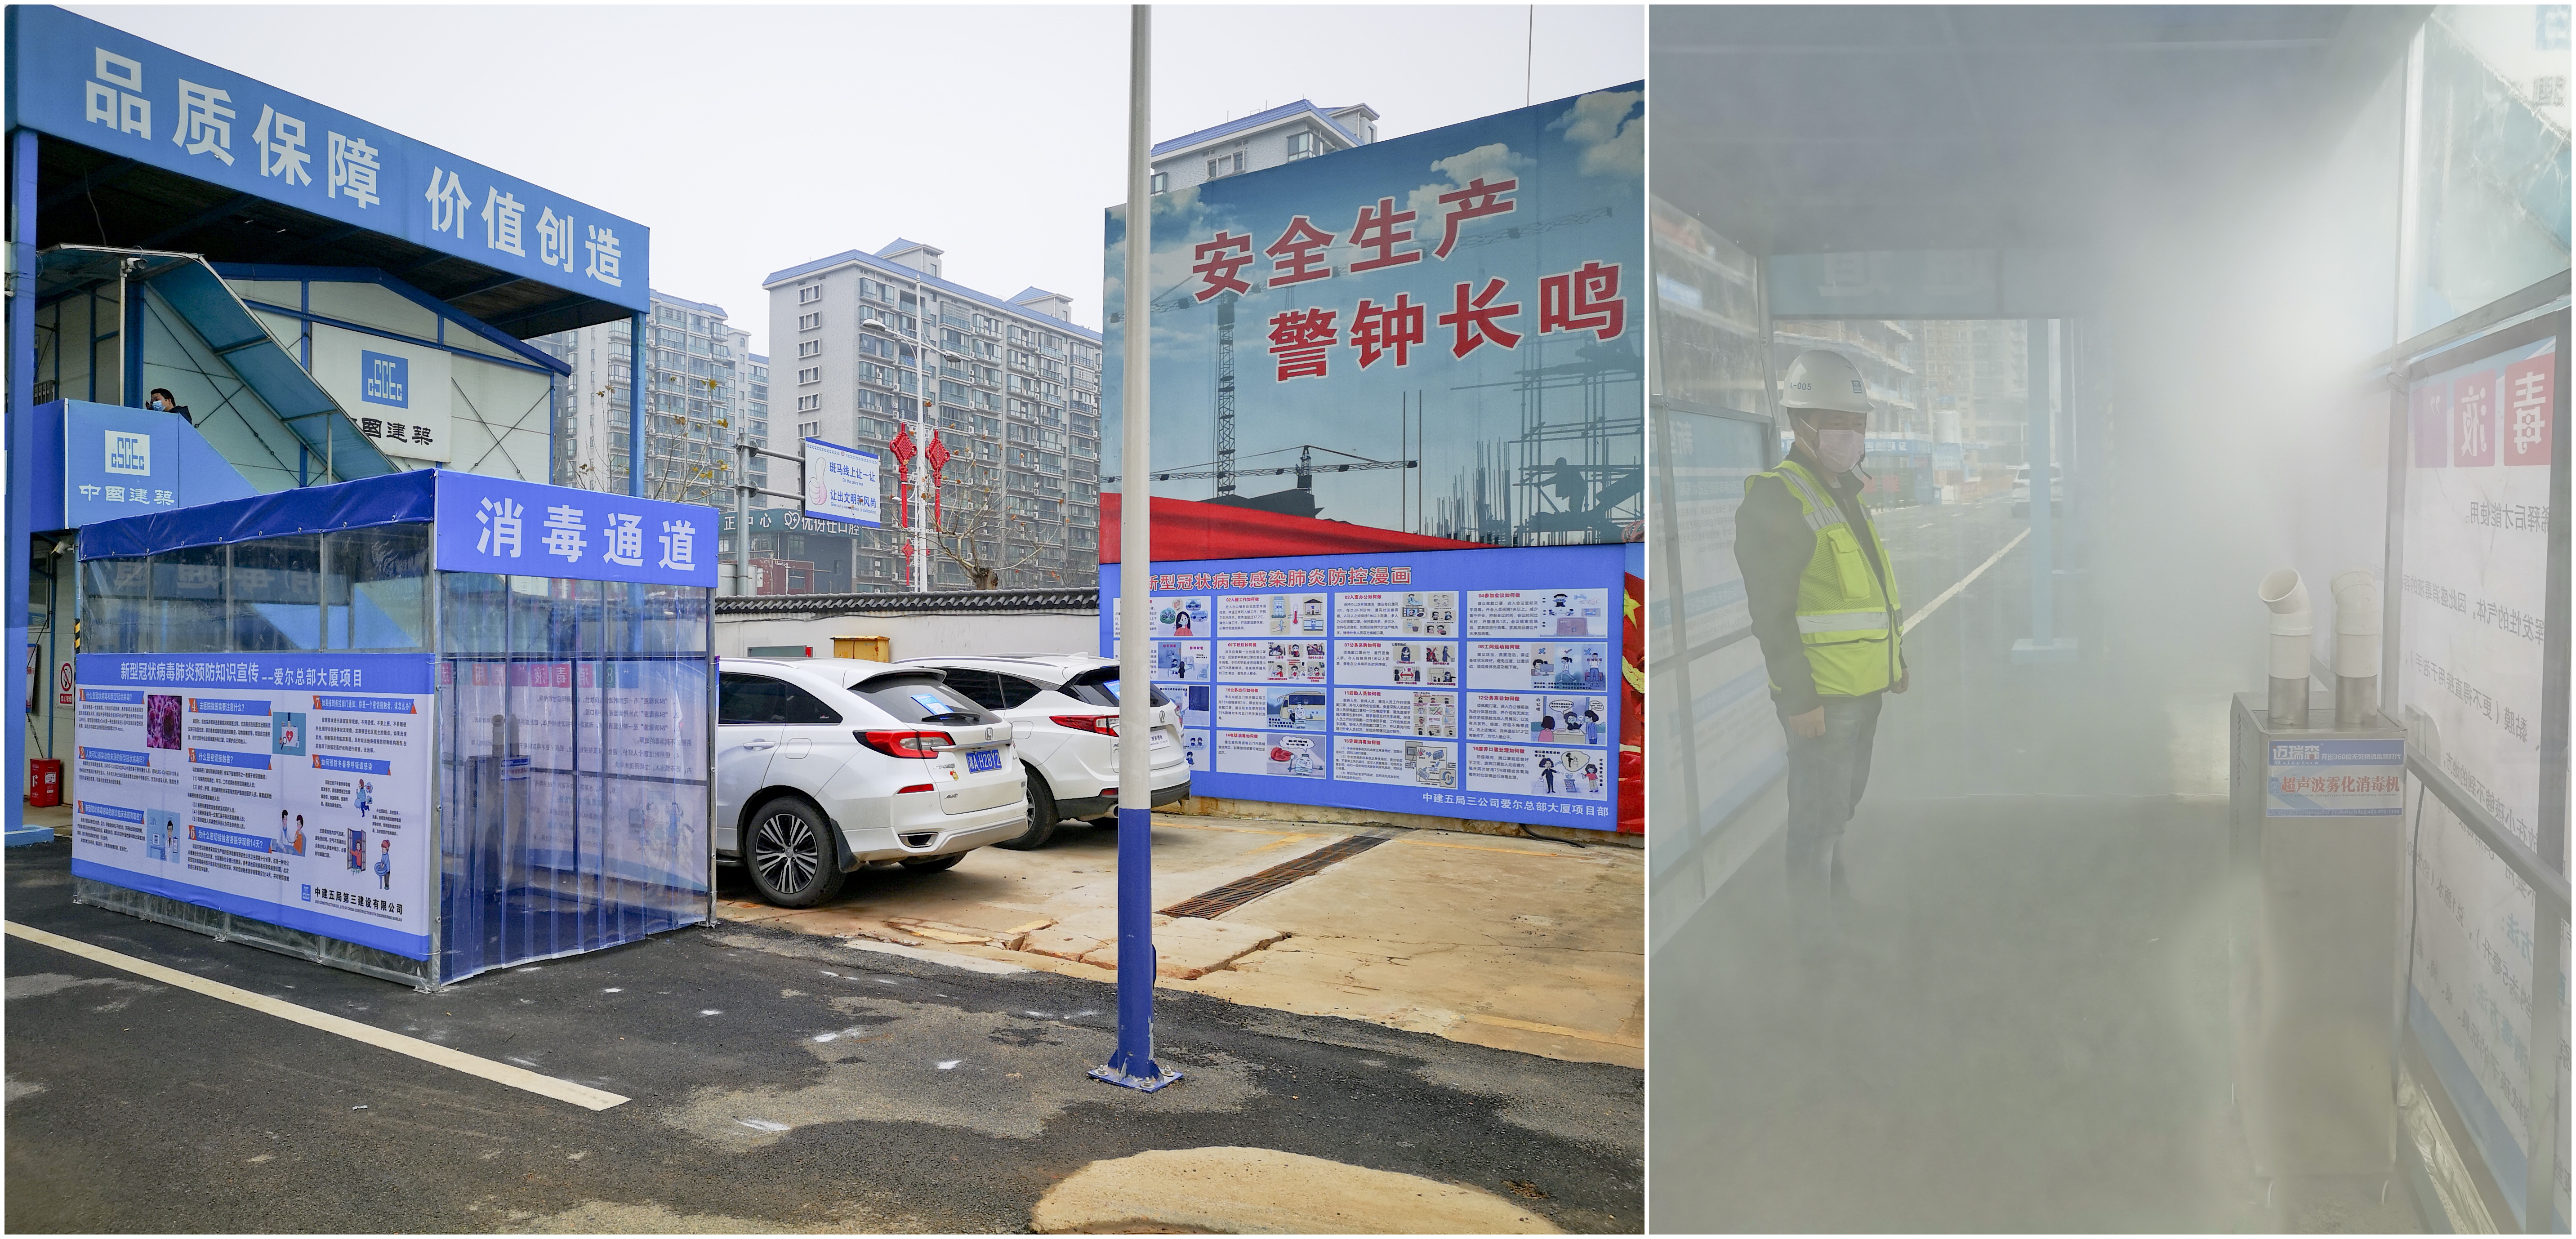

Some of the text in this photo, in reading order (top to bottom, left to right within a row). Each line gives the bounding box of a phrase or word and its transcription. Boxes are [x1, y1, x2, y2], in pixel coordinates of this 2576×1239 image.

[86, 47, 623, 288] 品质保障 价值创造
[1192, 177, 1520, 304] 安全生产
[1267, 259, 1628, 384] 警钟长鸣
[1789, 382, 1811, 391] A-005
[351, 417, 433, 446] 國建築
[829, 462, 875, 482] 斑马线上让一让
[79, 483, 174, 506] 中國建築
[830, 489, 876, 508] 让出文明新风尚
[475, 497, 695, 571] 消毒通道
[1150, 566, 1412, 592] 新型冠状病毒感染肺炎防控漫画
[120, 662, 258, 683] 新型冠状病毒肺炎预防知识宣传
[81, 690, 85, 701] 1
[316, 698, 320, 708] 7
[192, 699, 196, 712] 4
[80, 748, 84, 759] 2
[191, 750, 195, 762] 5
[315, 757, 319, 767] 8
[2273, 745, 2319, 760] 迈瑞森
[2281, 775, 2400, 793] 超声波雾化消毒机
[80, 802, 84, 813] 3
[1422, 793, 1609, 817] 中建五局三公司爱尔总部大厦项目部
[191, 827, 195, 839] 6
[315, 887, 402, 915] 中建五局第三建设有限公司
